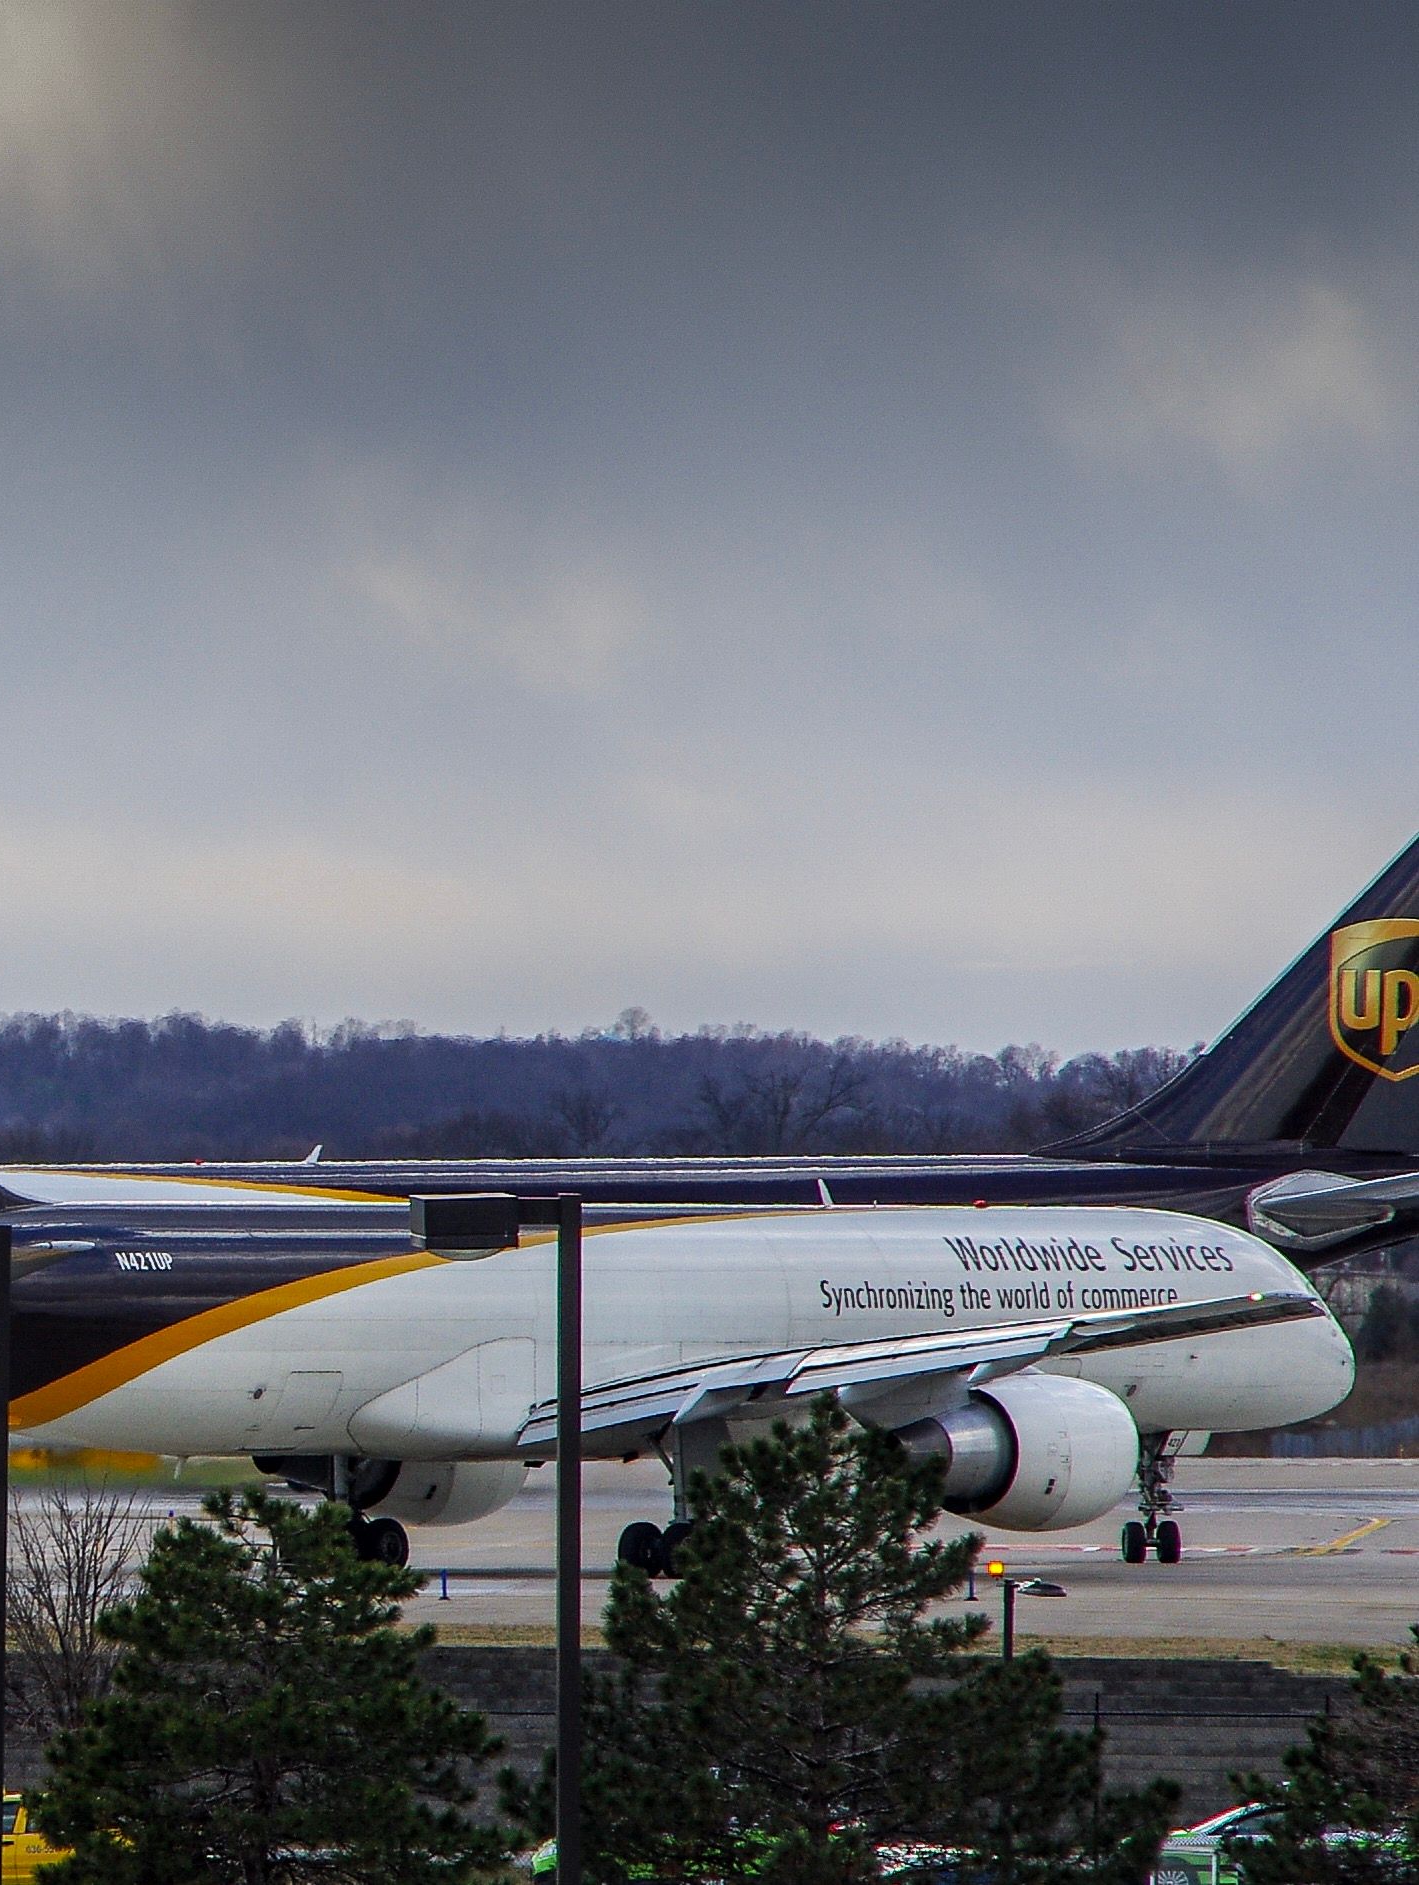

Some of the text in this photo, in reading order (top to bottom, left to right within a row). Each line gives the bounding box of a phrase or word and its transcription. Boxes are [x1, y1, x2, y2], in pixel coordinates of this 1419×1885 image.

[115, 1252, 173, 1271] N421UP
[943, 1236, 1234, 1272] Worldwide Services
[819, 1279, 1179, 1317] Synchronizing the world of commerce
